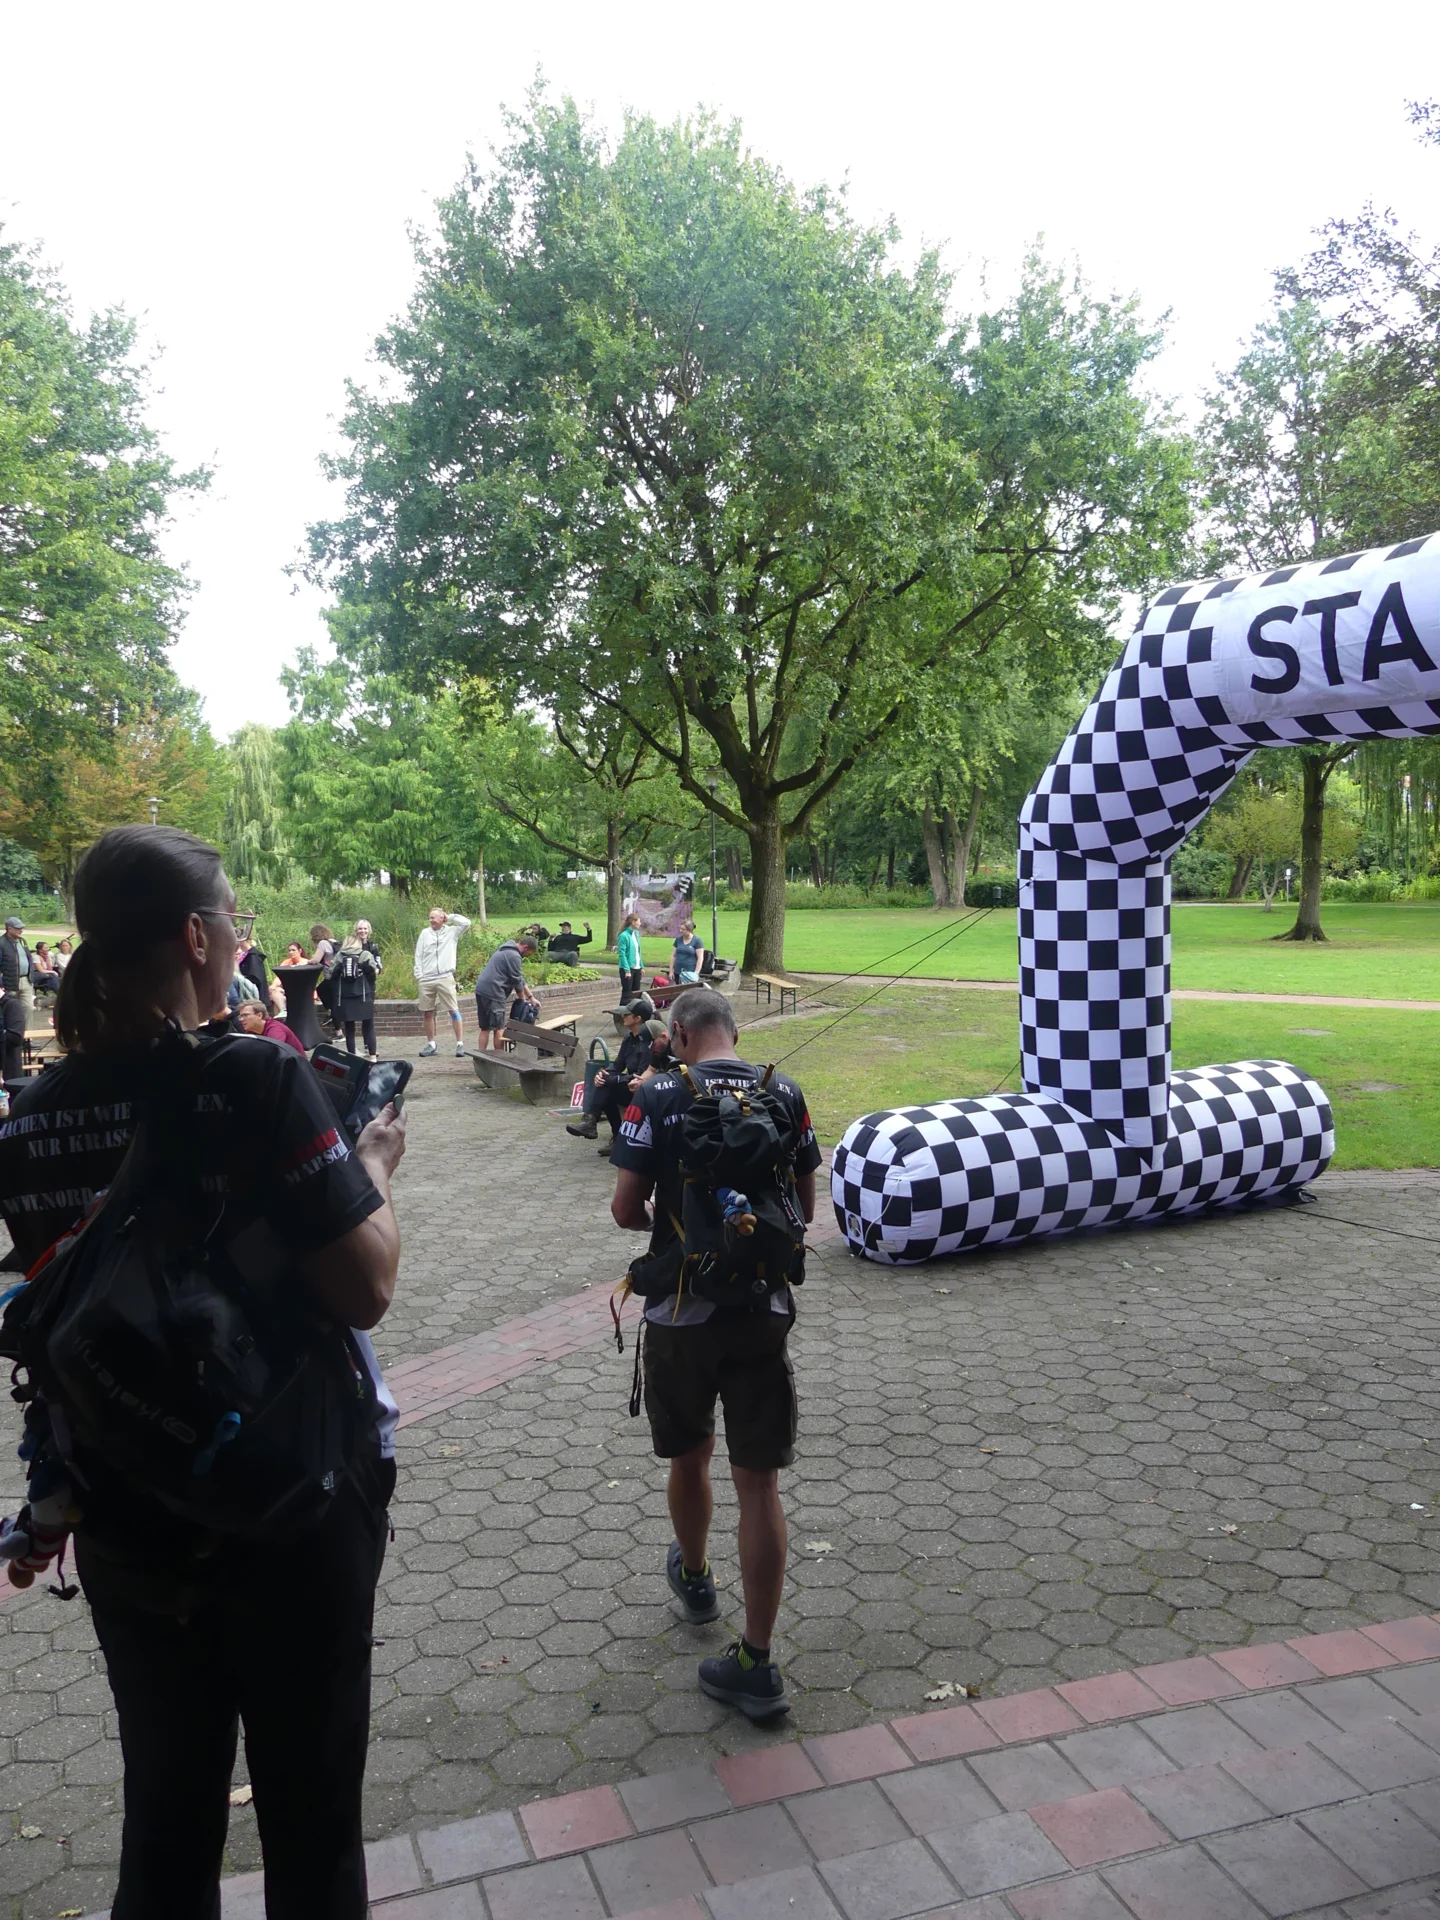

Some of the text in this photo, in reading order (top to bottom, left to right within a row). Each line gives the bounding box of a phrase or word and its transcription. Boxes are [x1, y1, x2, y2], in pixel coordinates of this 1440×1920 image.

[1247, 581, 1438, 694] STA
[55, 1109, 88, 1129] IST
[93, 1102, 132, 1123] WIE
[28, 1138, 62, 1159] NUR
